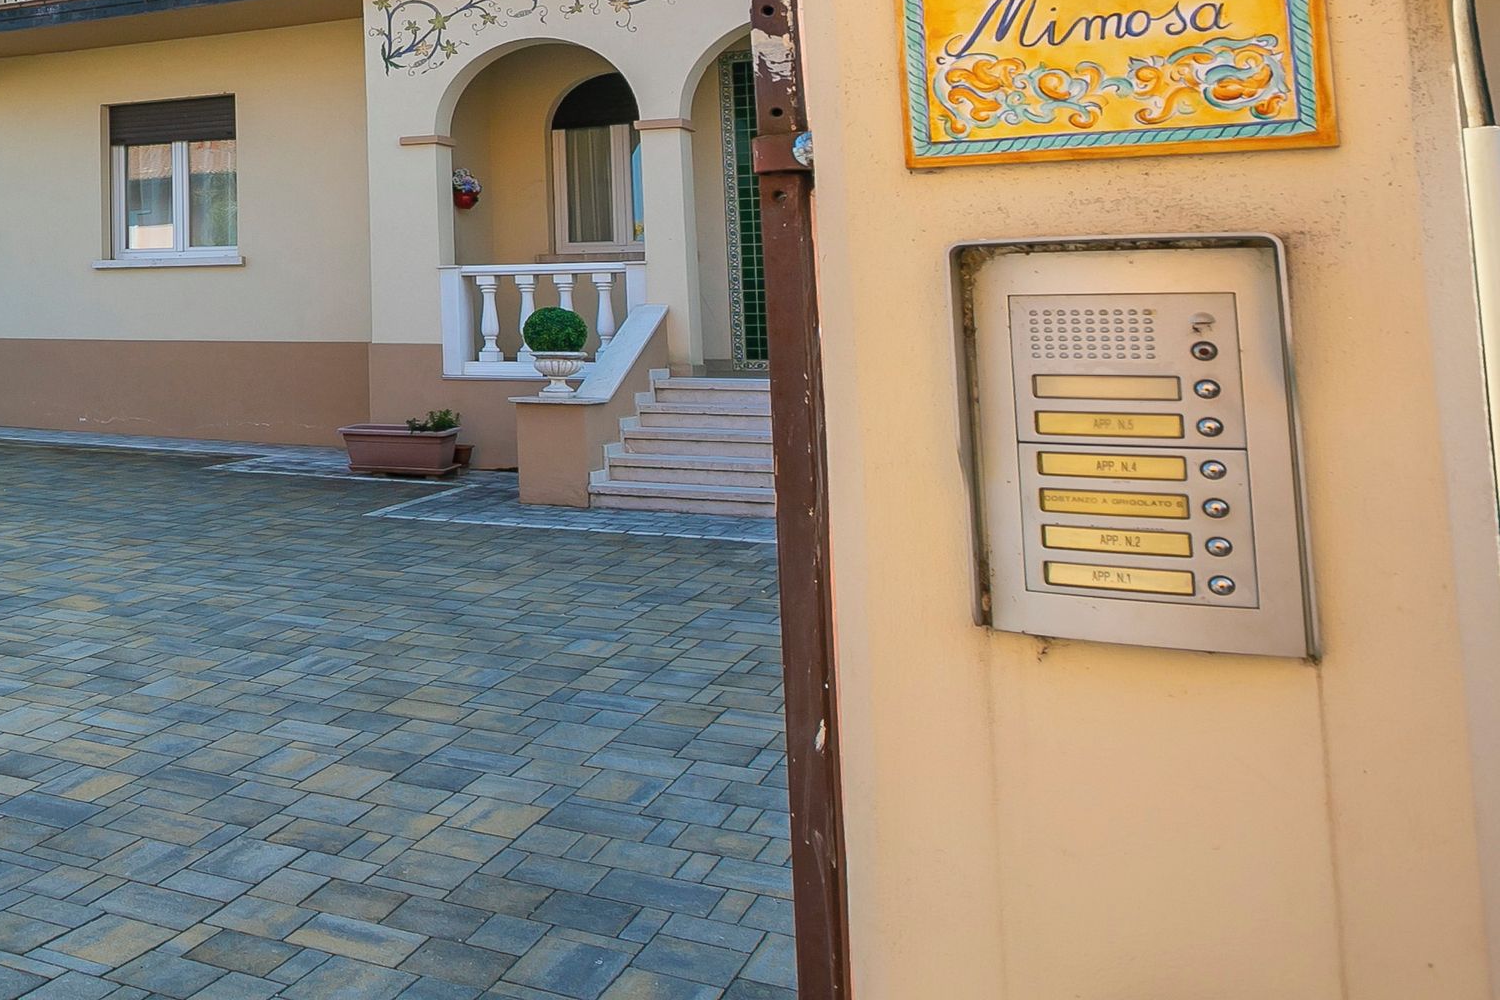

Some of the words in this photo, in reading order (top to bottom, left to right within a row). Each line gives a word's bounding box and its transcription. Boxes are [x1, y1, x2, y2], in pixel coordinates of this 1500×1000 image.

[1118, 419, 1134, 430] N.5
[1096, 460, 1118, 472] APP.
[1120, 461, 1137, 472] N.4
[1100, 534, 1121, 546] APP.
[1125, 535, 1141, 548] N.2
[1092, 570, 1114, 583] APP.
[1116, 572, 1131, 585] N.1
